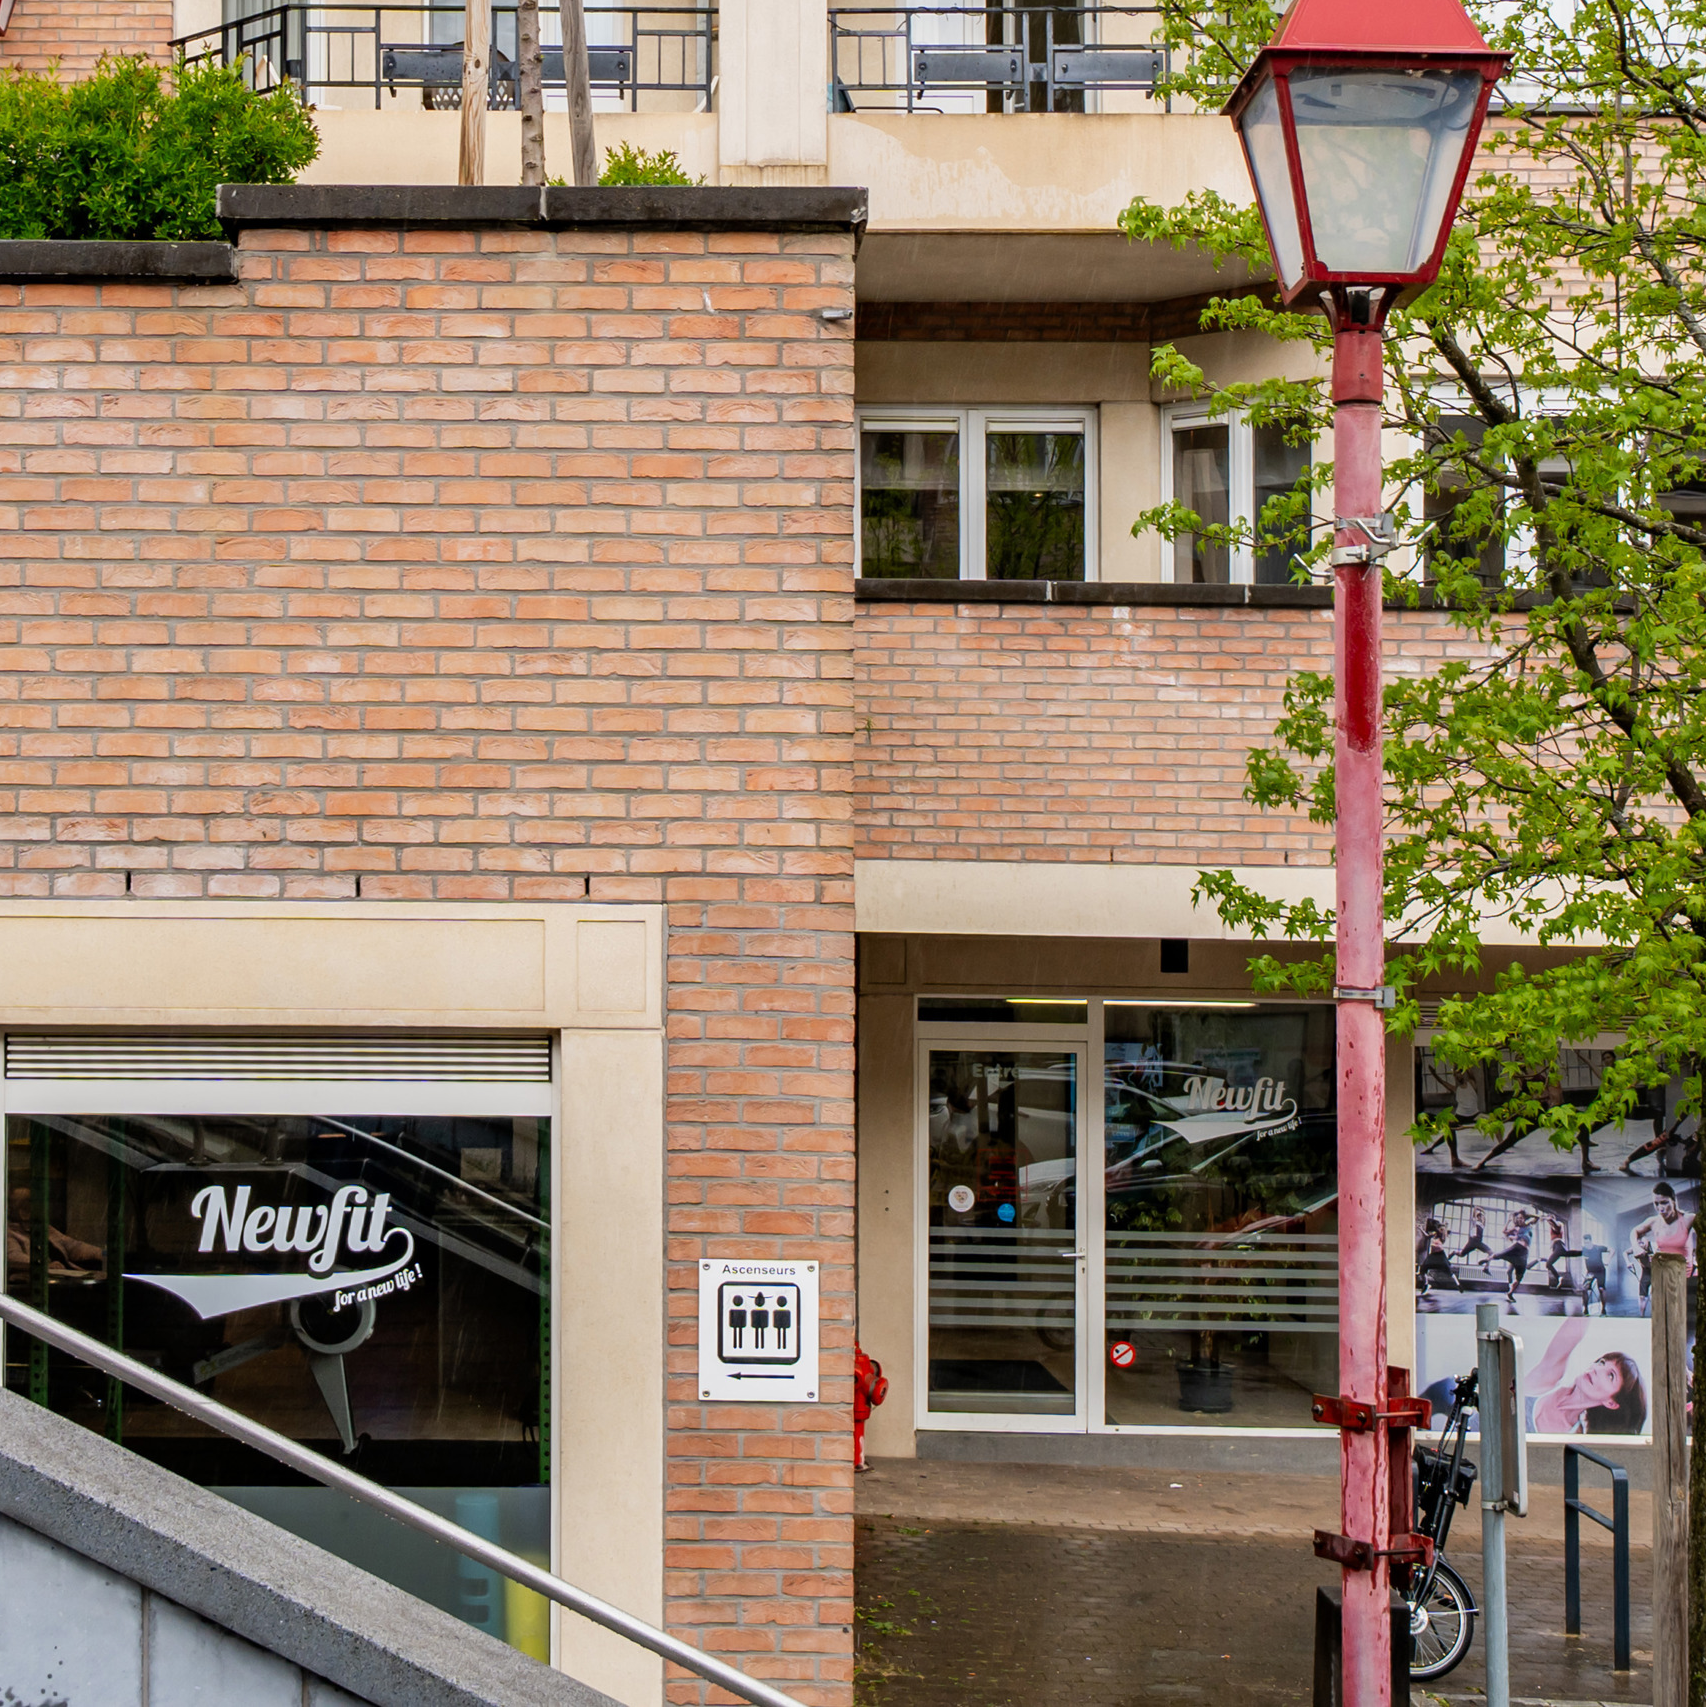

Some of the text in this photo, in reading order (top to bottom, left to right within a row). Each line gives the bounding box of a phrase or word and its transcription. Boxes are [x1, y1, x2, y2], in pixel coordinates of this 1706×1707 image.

[1183, 1076, 1286, 1120] Newfit
[1256, 1130, 1268, 1142] for
[1273, 1125, 1288, 1135] new
[1287, 1119, 1299, 1131] life
[190, 1184, 393, 1273] Newfit
[333, 1262, 424, 1313] for a new life !
[722, 1264, 796, 1276] Ascenseurs
